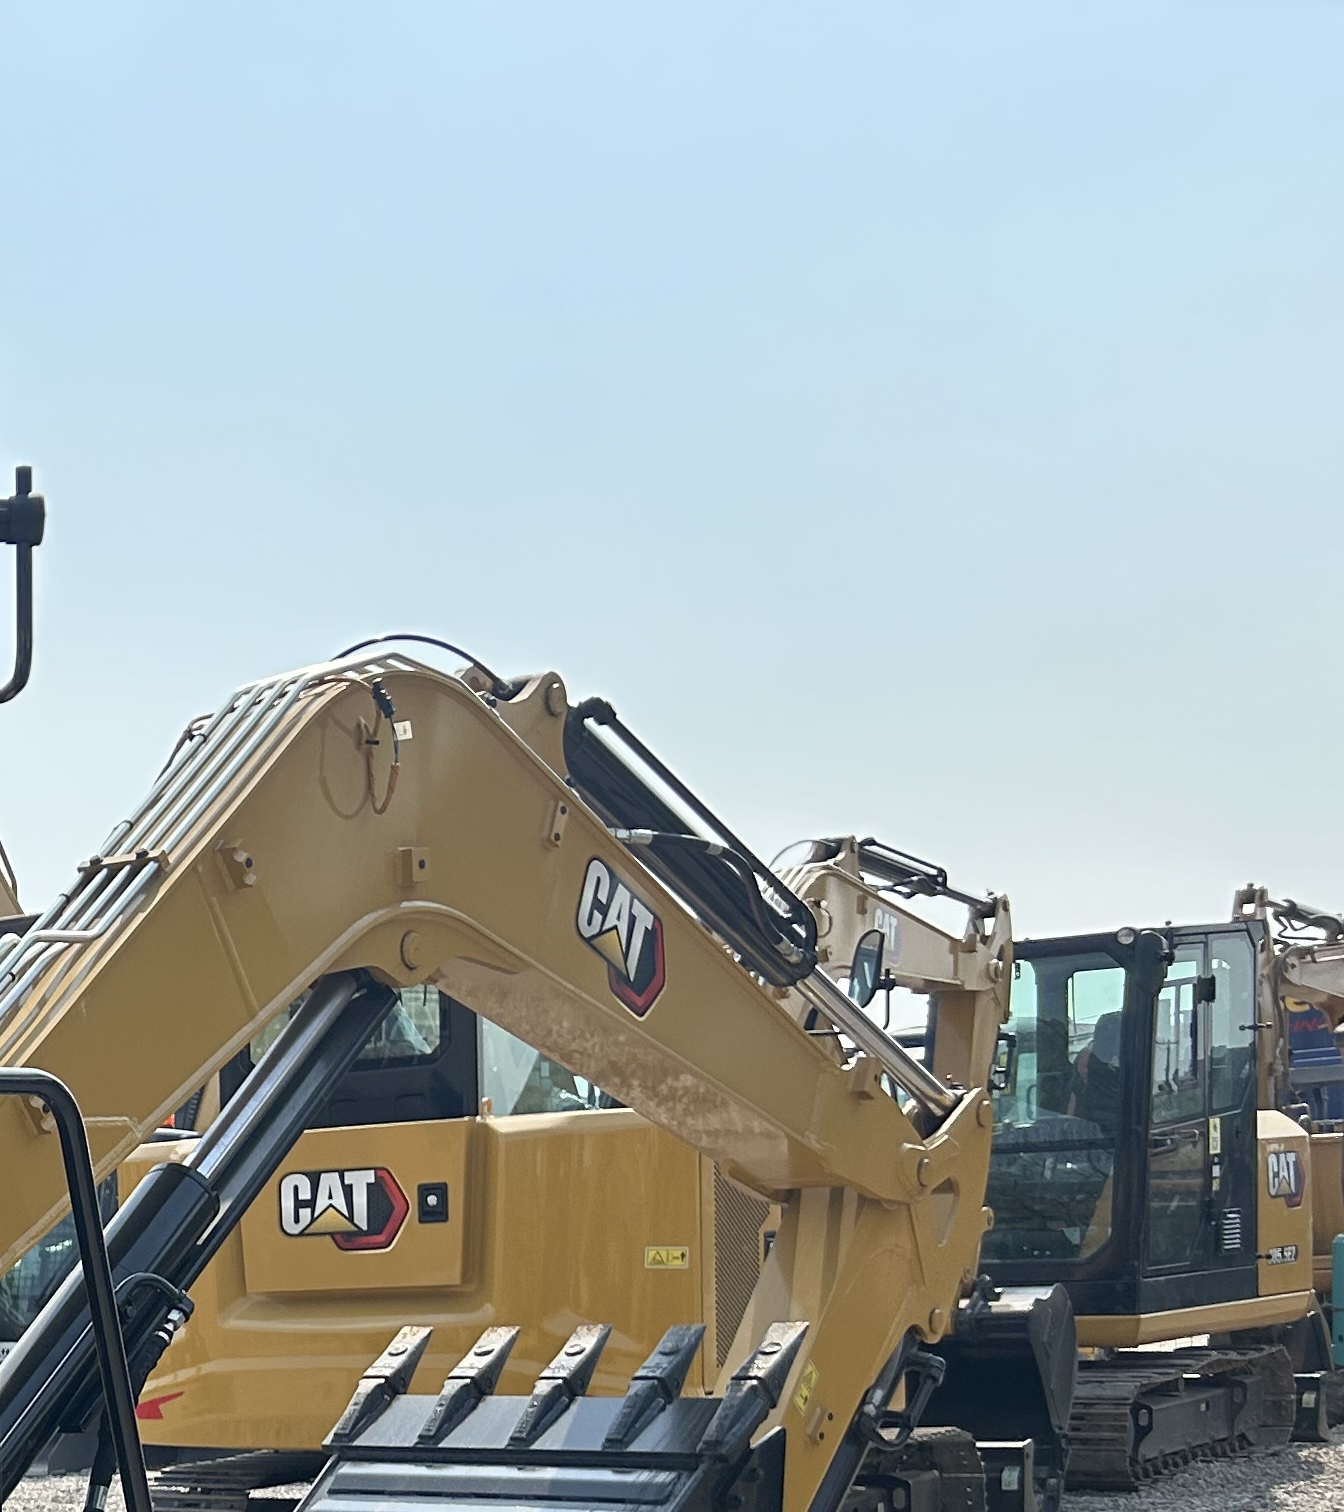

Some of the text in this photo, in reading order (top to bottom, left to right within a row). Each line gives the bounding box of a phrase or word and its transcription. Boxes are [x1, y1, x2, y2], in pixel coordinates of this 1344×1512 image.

[578, 860, 654, 982] CAT
[281, 1169, 376, 1234] CAT
[1268, 1152, 1296, 1196] CAT
